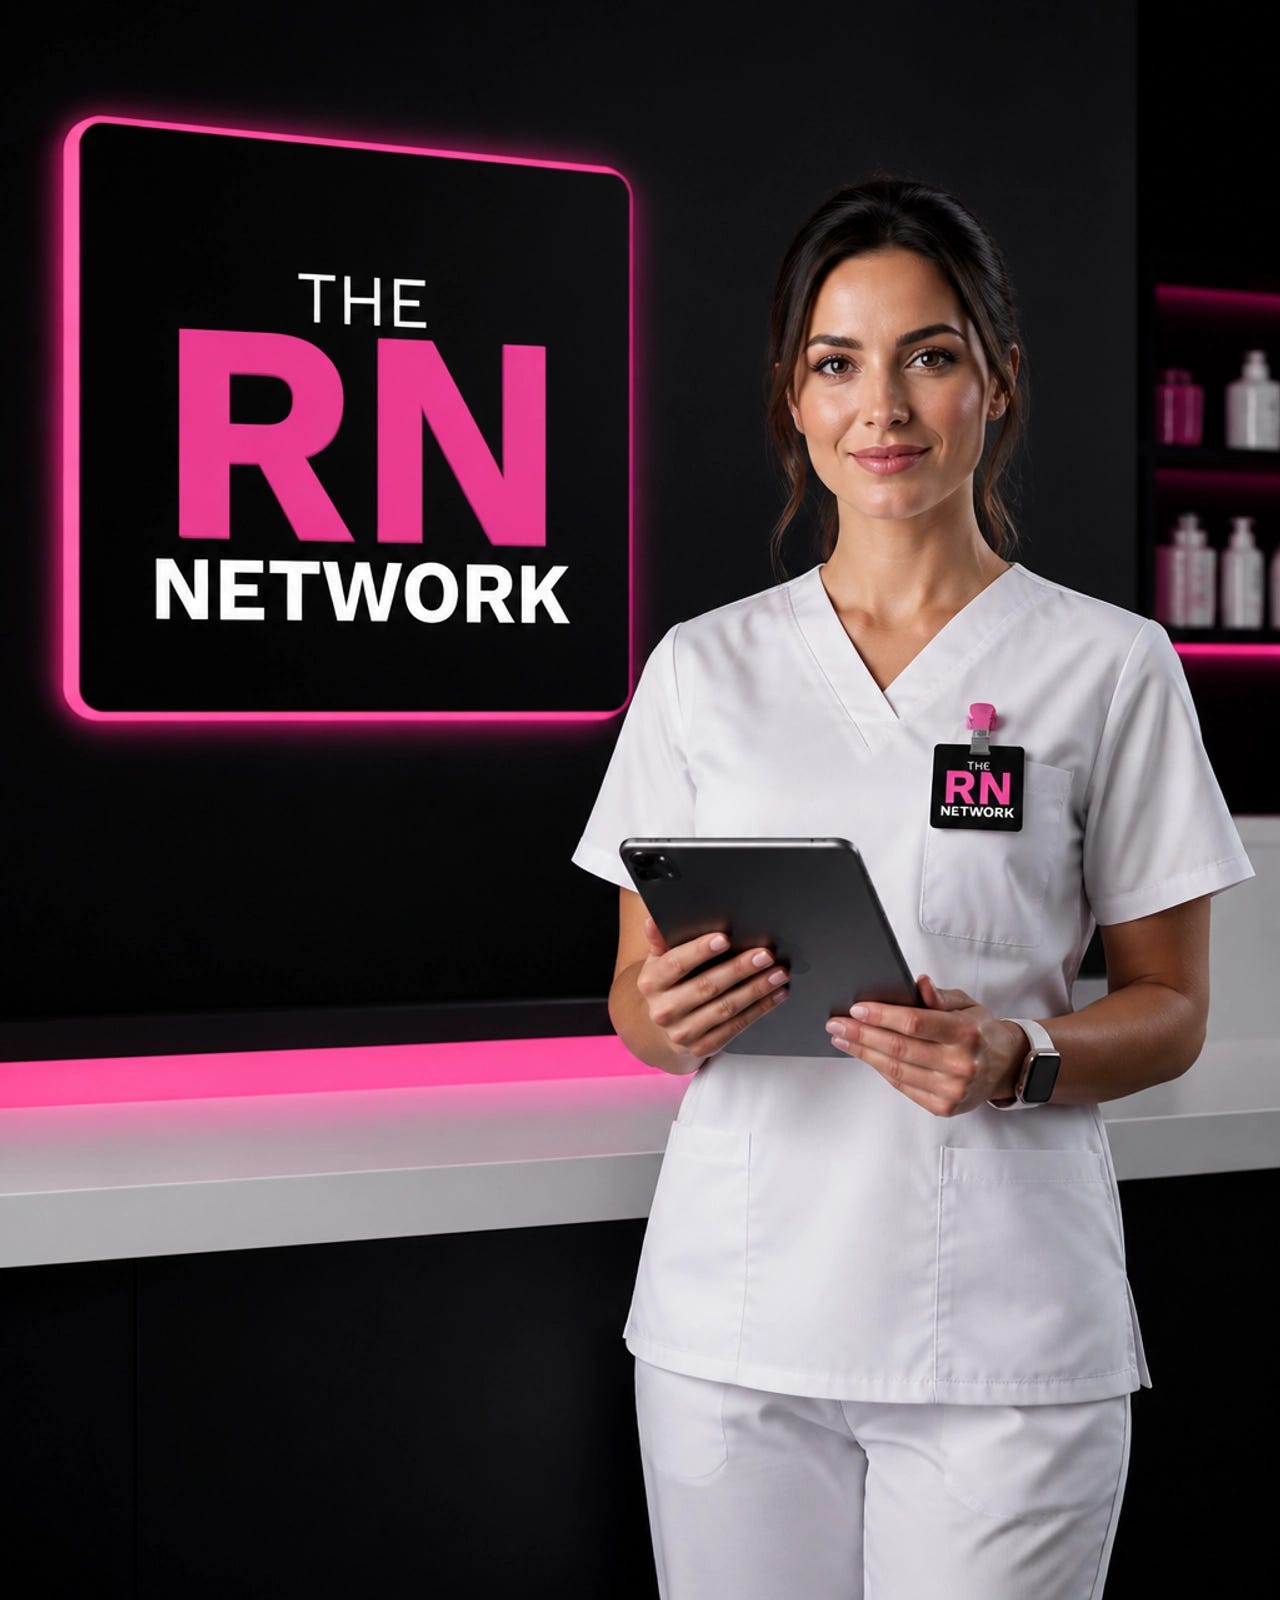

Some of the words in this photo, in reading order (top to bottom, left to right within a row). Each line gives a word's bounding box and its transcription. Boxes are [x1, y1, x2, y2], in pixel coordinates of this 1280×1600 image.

[298, 273, 427, 329] THE
[179, 329, 546, 547] RN
[155, 558, 570, 624] NETWORK
[945, 769, 1011, 806] RN
[967, 761, 991, 771] THE
[940, 805, 1015, 819] NETWORK
